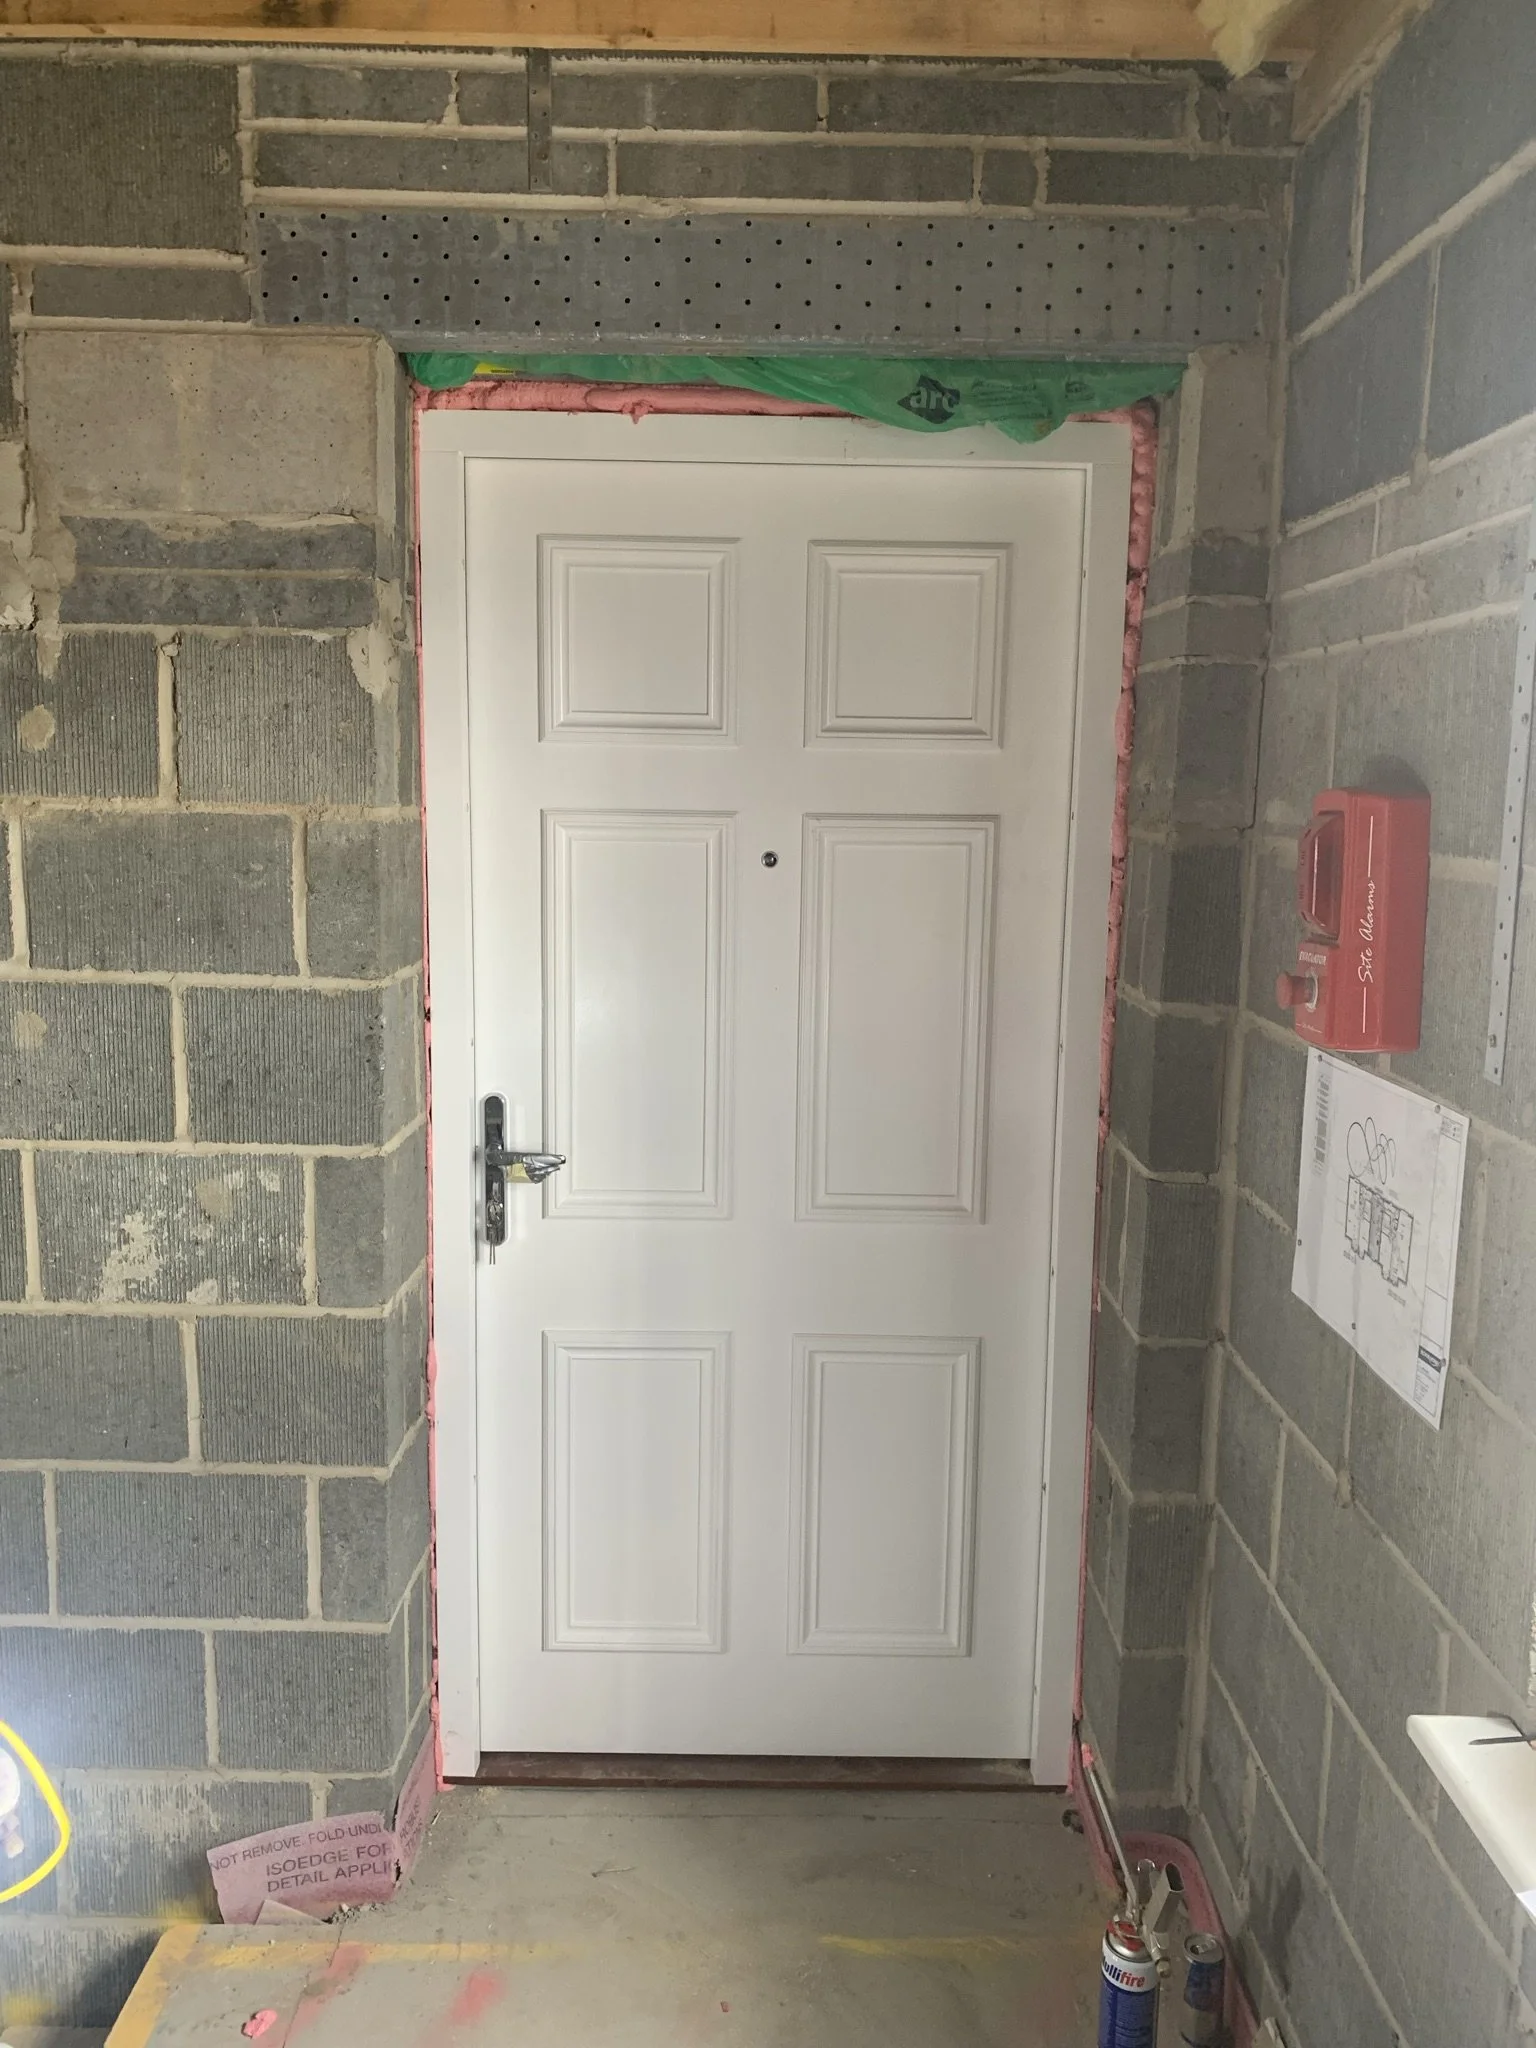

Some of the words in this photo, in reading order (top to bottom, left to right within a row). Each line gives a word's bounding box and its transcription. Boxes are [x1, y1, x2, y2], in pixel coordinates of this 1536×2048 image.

[1359, 880, 1376, 941] Alarms
[1358, 947, 1373, 983] Site
[308, 1828, 345, 1845] FOLD
[266, 1850, 349, 1876] ISOEDGE
[268, 1871, 329, 1893] DETAIL
[1103, 1957, 1146, 1988] ullifire
